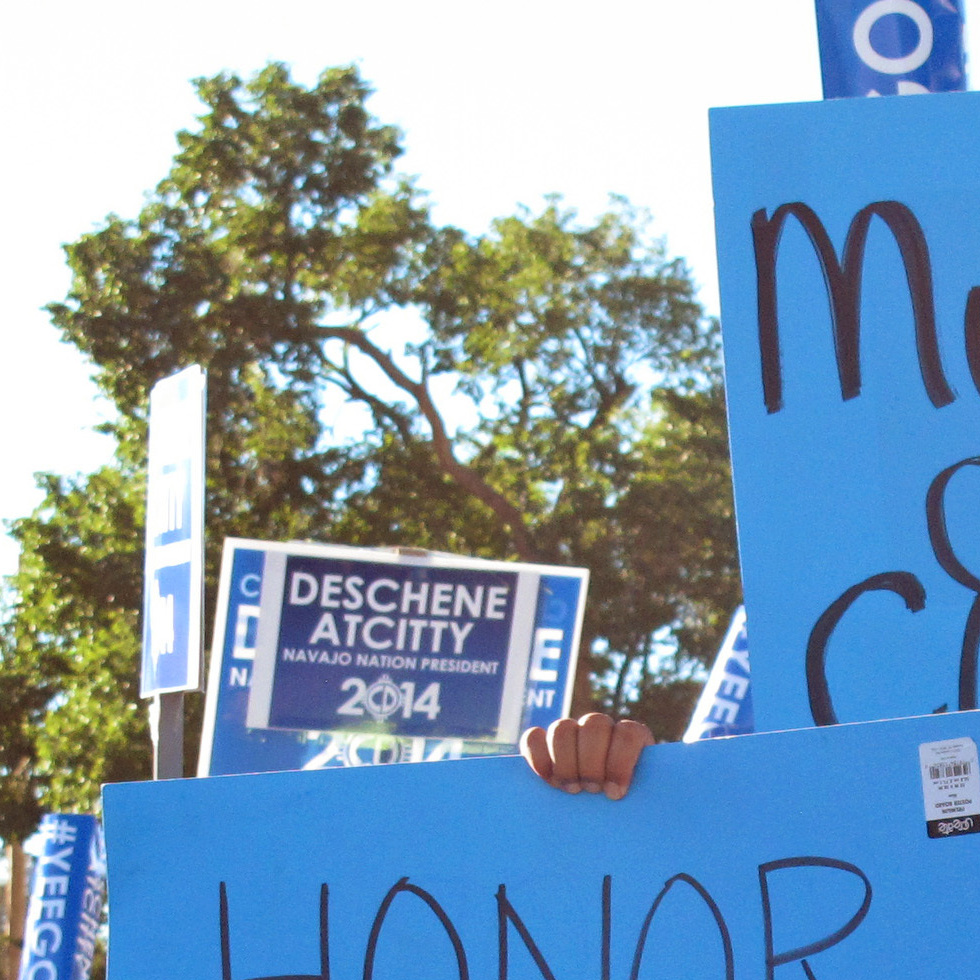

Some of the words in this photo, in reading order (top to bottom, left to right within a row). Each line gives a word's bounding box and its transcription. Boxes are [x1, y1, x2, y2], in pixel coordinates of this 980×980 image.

[289, 571, 509, 620] DESCHENE
[308, 612, 475, 655] ATCITTY
[283, 647, 352, 666] NAVAJO
[356, 653, 417, 670] NATION
[420, 657, 499, 675] PRESIDENT
[336, 675, 441, 721] 2014
